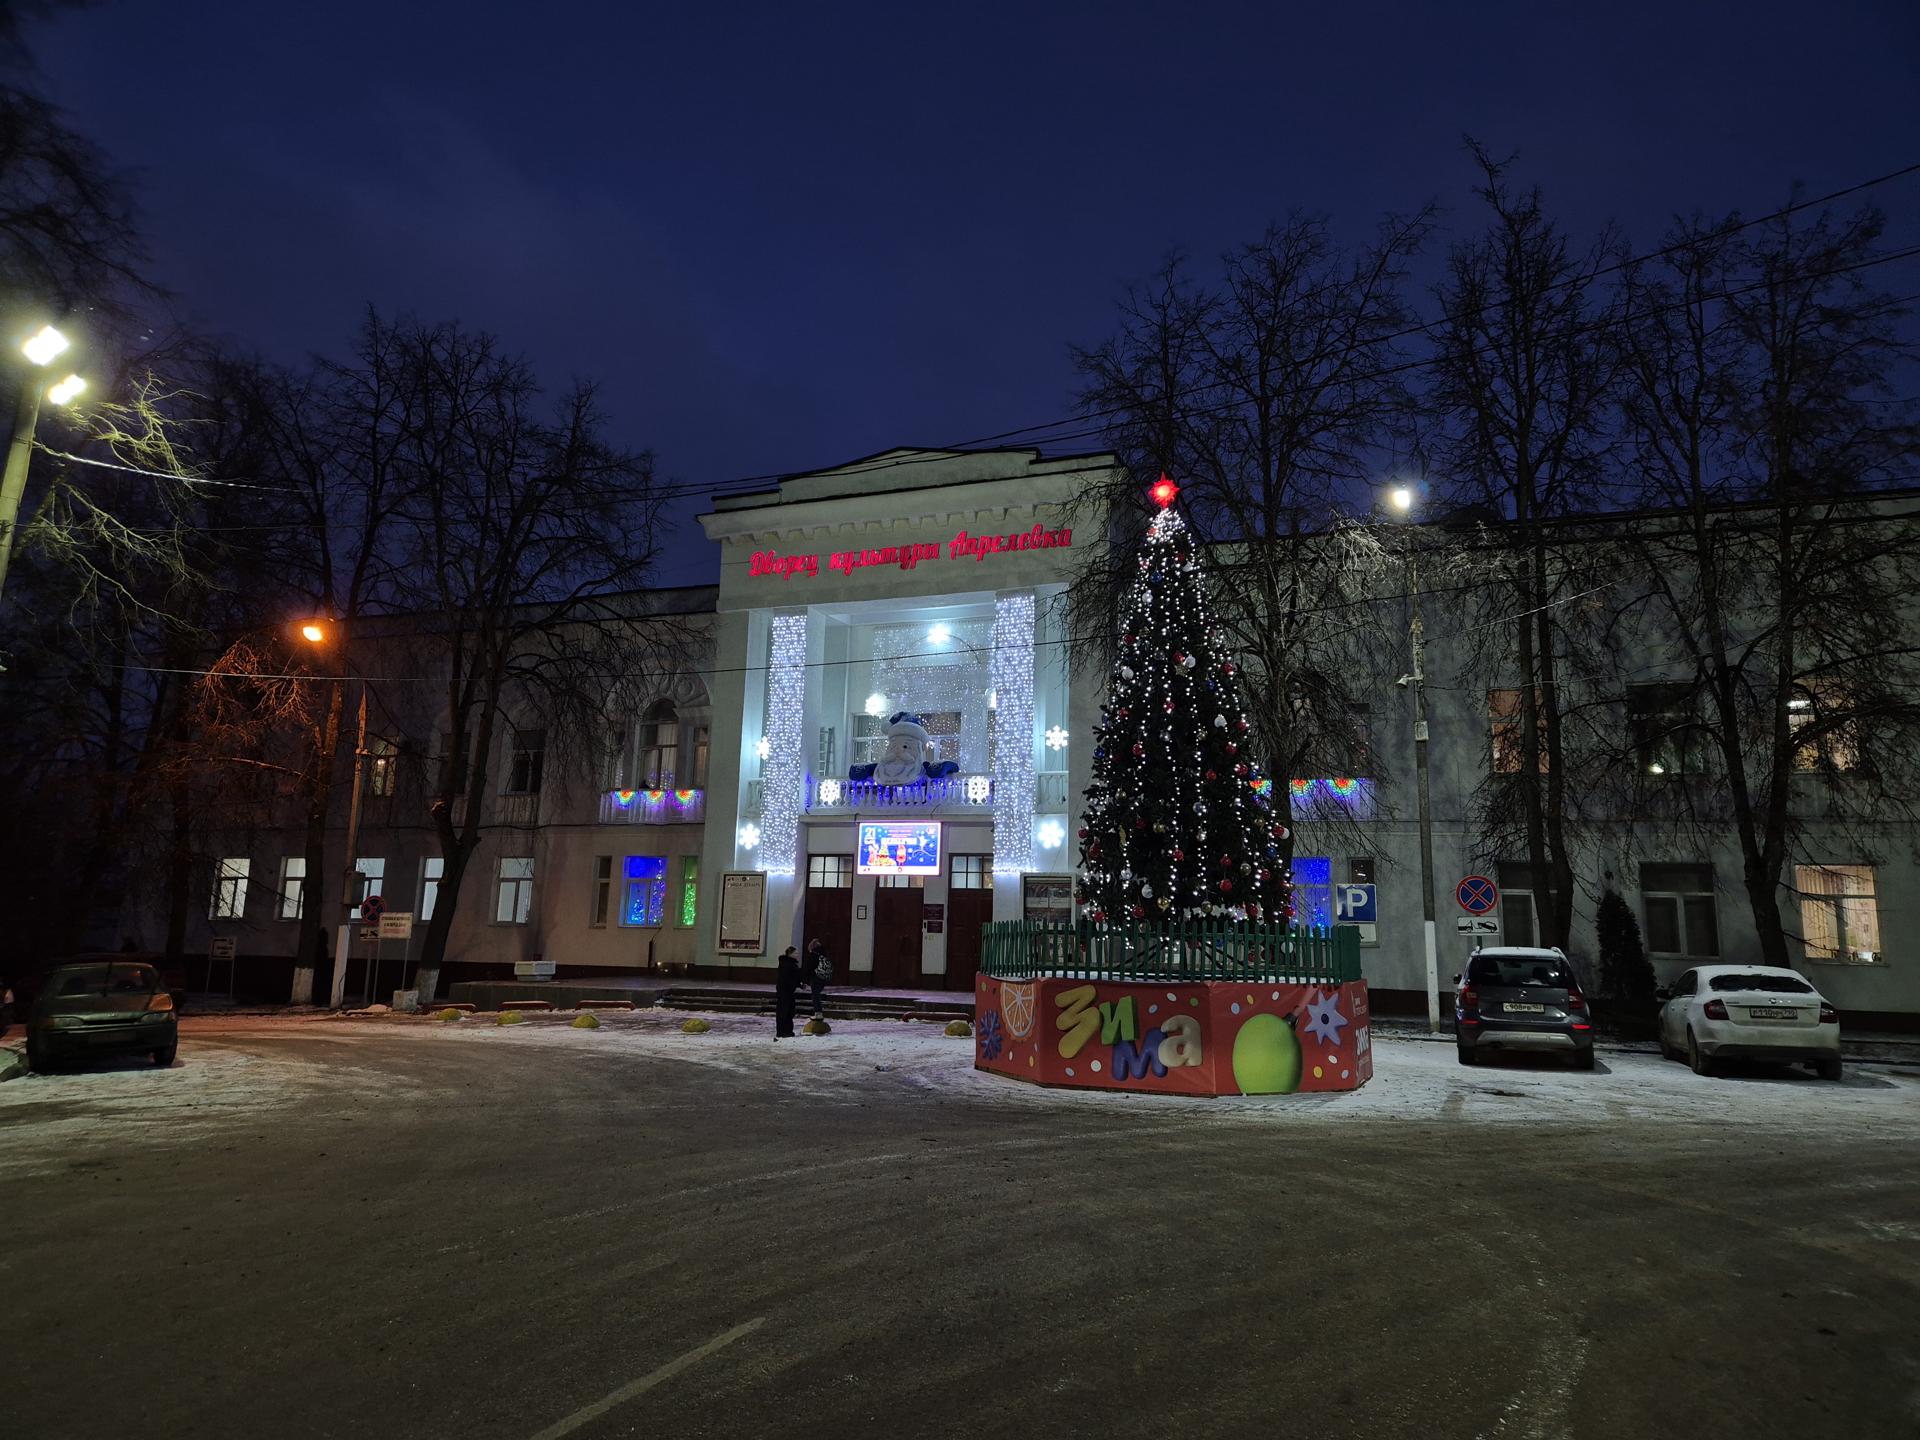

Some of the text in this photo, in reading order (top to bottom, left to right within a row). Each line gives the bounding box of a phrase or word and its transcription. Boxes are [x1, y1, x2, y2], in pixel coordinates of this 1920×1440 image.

[749, 523, 1073, 580] Дворец культуры Апрелевка
[1346, 888, 1368, 918] P
